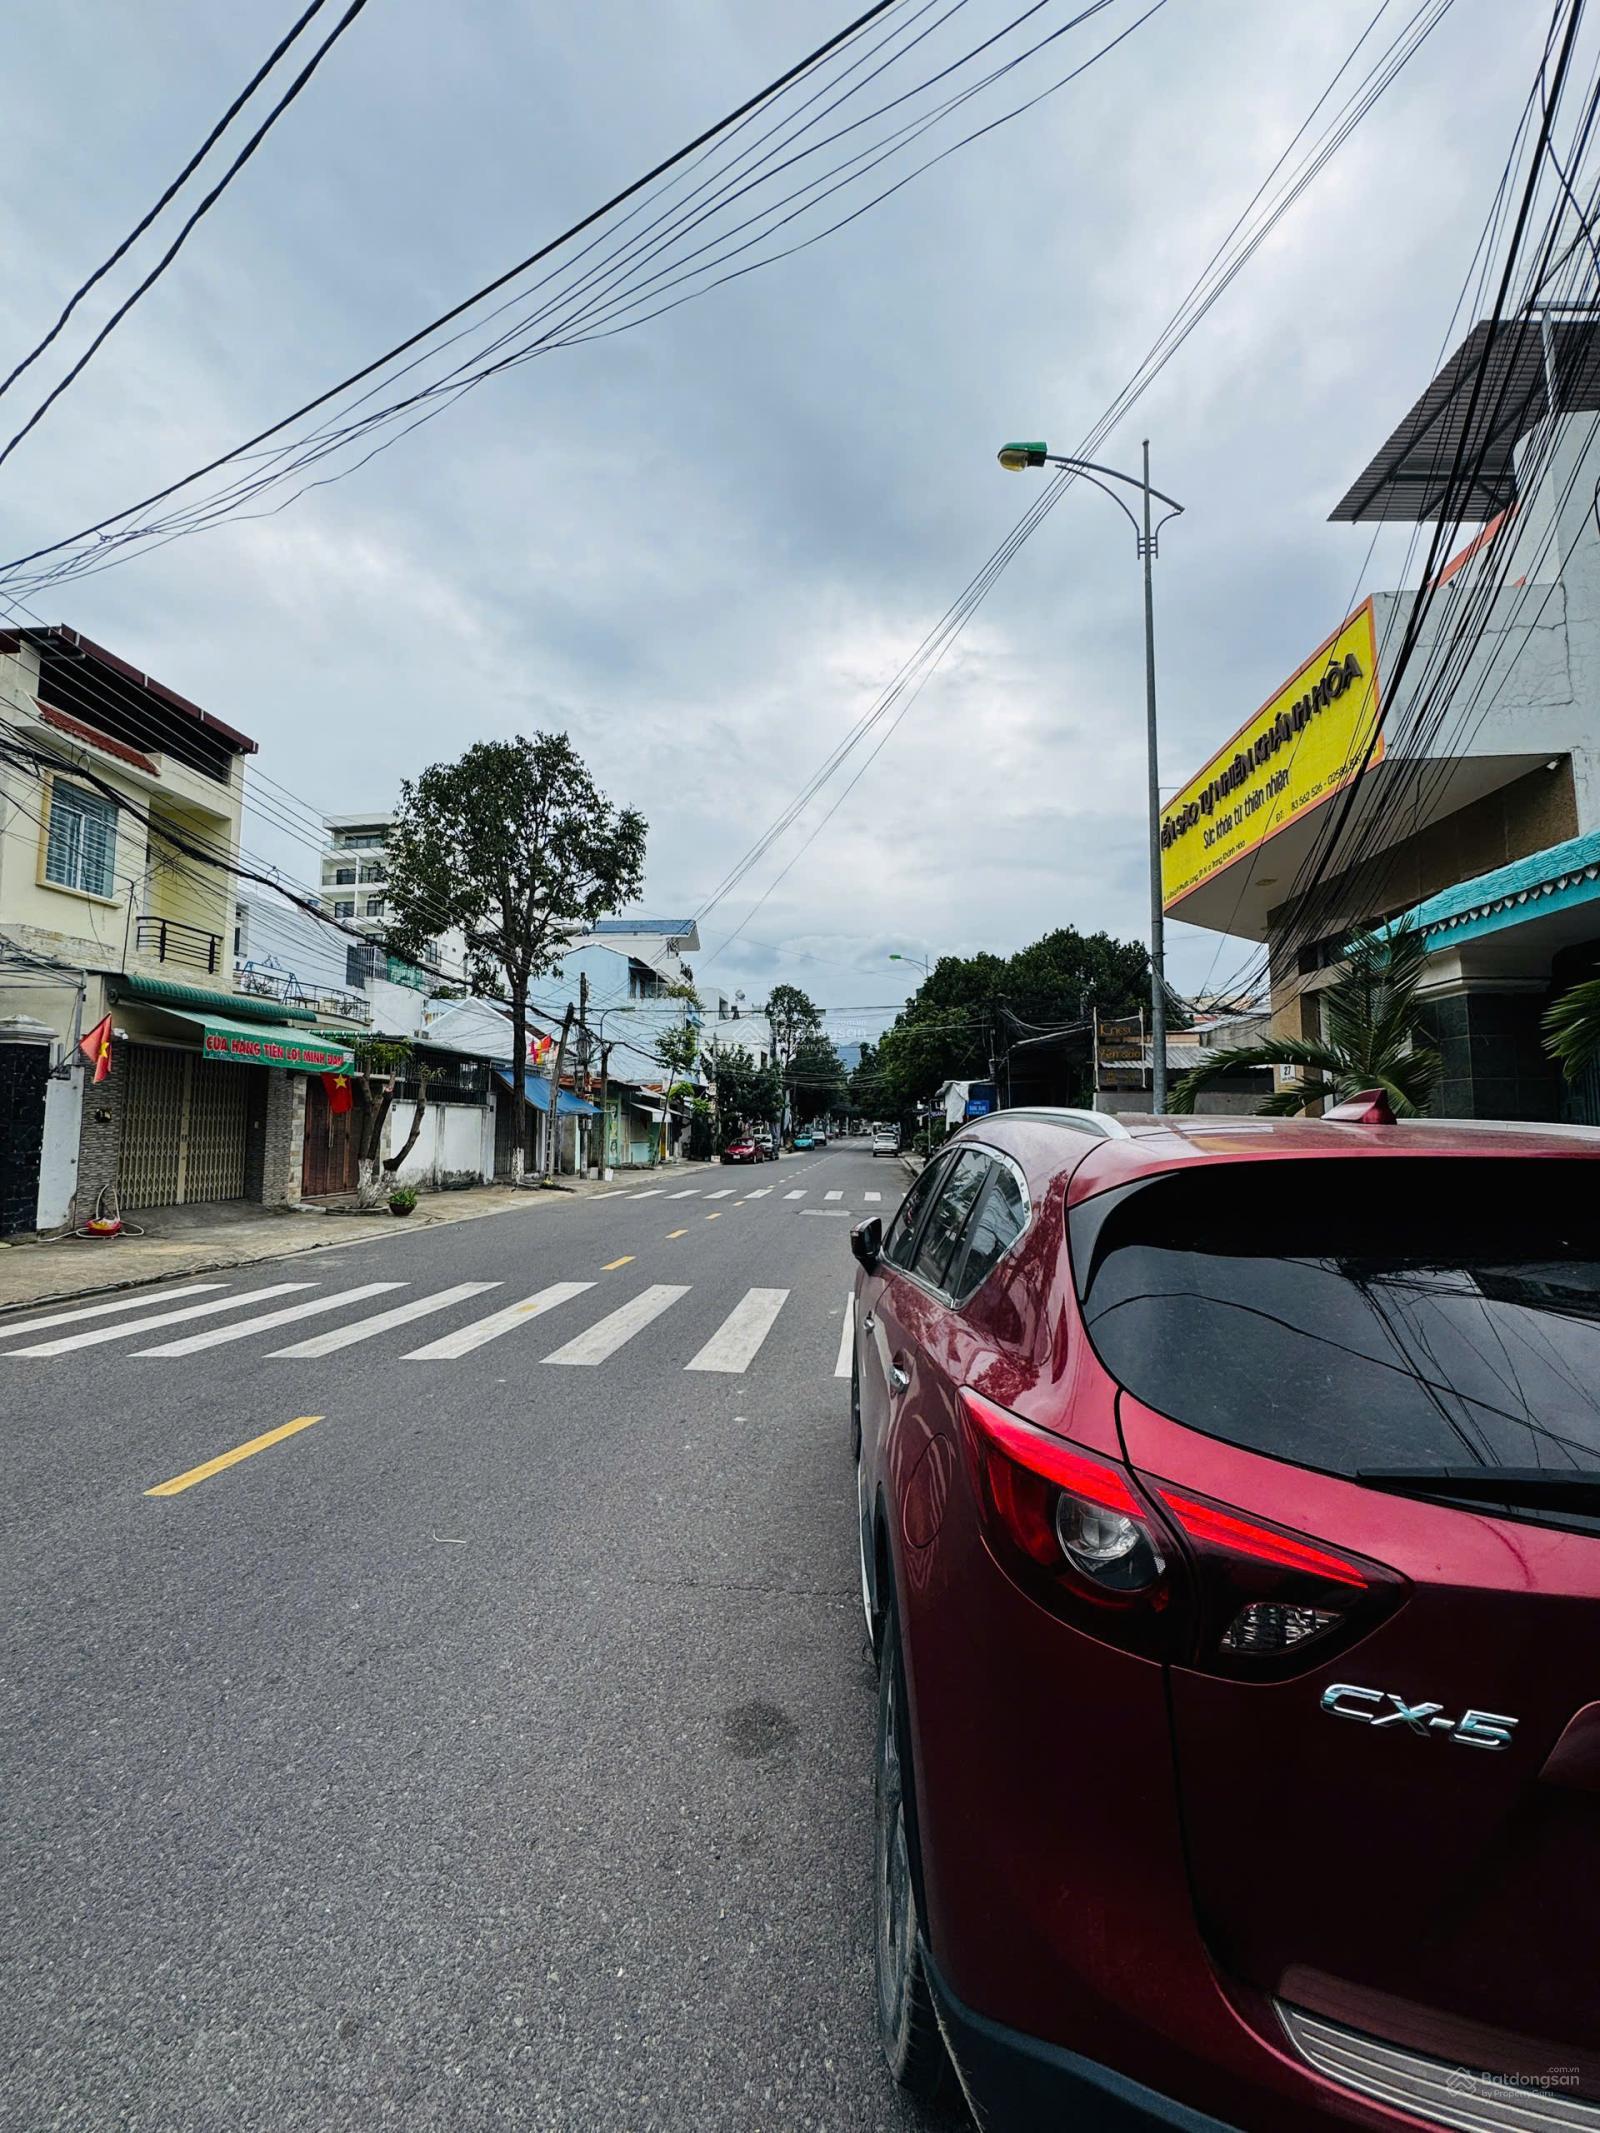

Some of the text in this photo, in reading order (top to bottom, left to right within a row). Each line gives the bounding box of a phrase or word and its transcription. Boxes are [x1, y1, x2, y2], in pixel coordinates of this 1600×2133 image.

[1161, 653, 1363, 851] ẾN SÀO TỰ NHIÊN KHÁNH HÒA
[1266, 768, 1291, 800] nhiên
[231, 1037, 261, 1057] HÀNG
[263, 1043, 284, 1062] TIỆN
[303, 1049, 325, 1065] MINH
[1284, 1065, 1292, 1076] 27
[1320, 1684, 1519, 1751] CX-5
